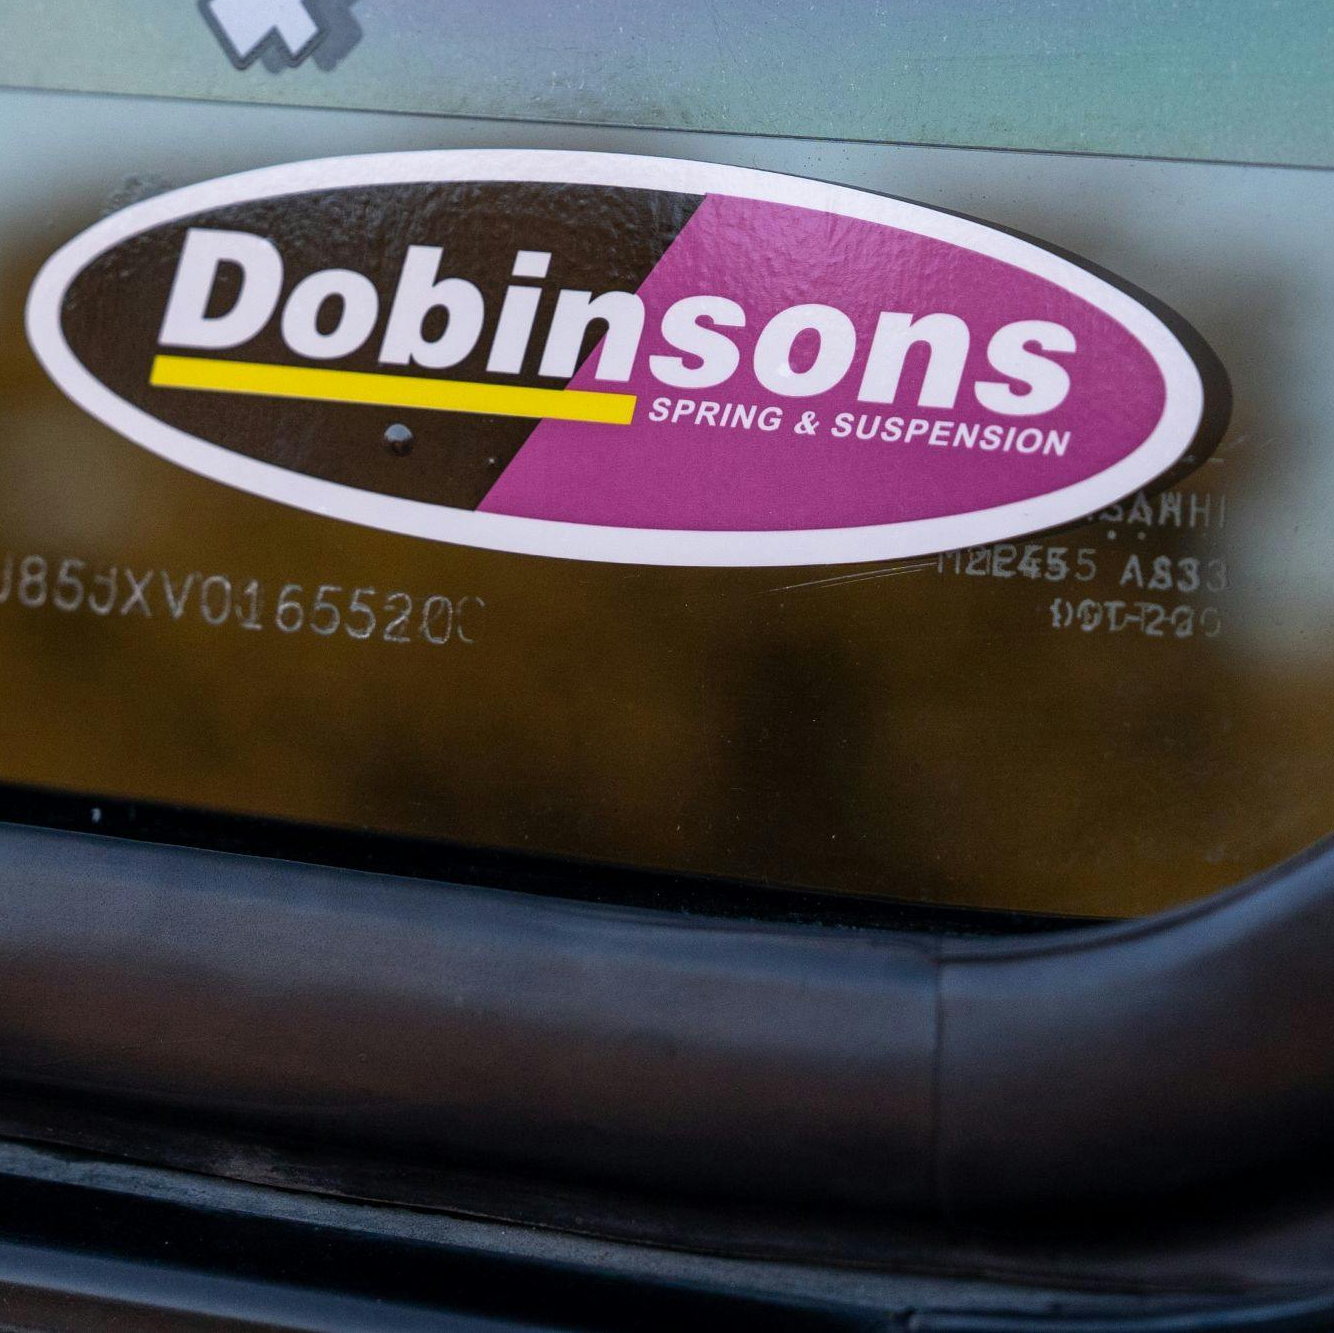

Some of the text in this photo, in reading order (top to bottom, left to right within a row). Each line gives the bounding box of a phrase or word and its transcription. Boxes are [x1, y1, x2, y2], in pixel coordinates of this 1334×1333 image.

[157, 228, 1079, 416] Dobinsons
[648, 397, 1072, 457] SPRING & SUSPENSION
